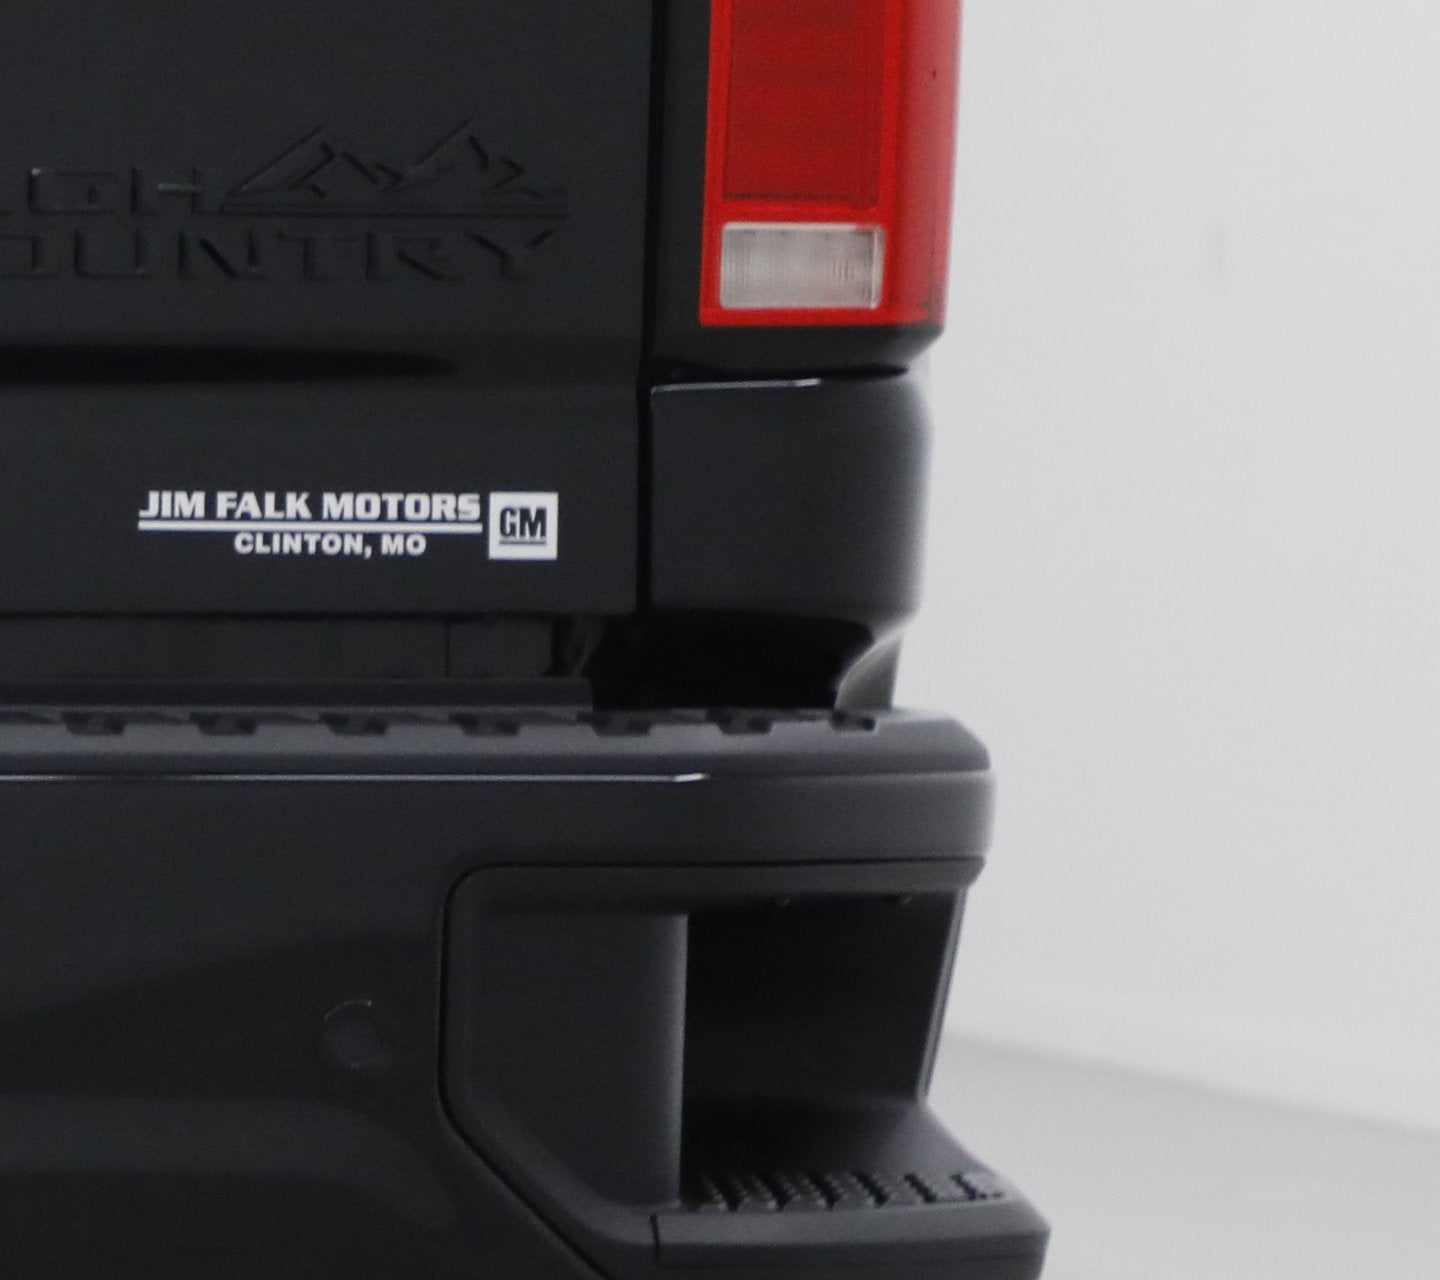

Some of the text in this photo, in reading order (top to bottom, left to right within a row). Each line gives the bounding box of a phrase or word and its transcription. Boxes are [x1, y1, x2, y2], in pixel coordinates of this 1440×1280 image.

[138, 490, 481, 522] JIM FALK MOTORS
[498, 506, 548, 540] GM
[233, 532, 427, 560] CLINTON, MO
